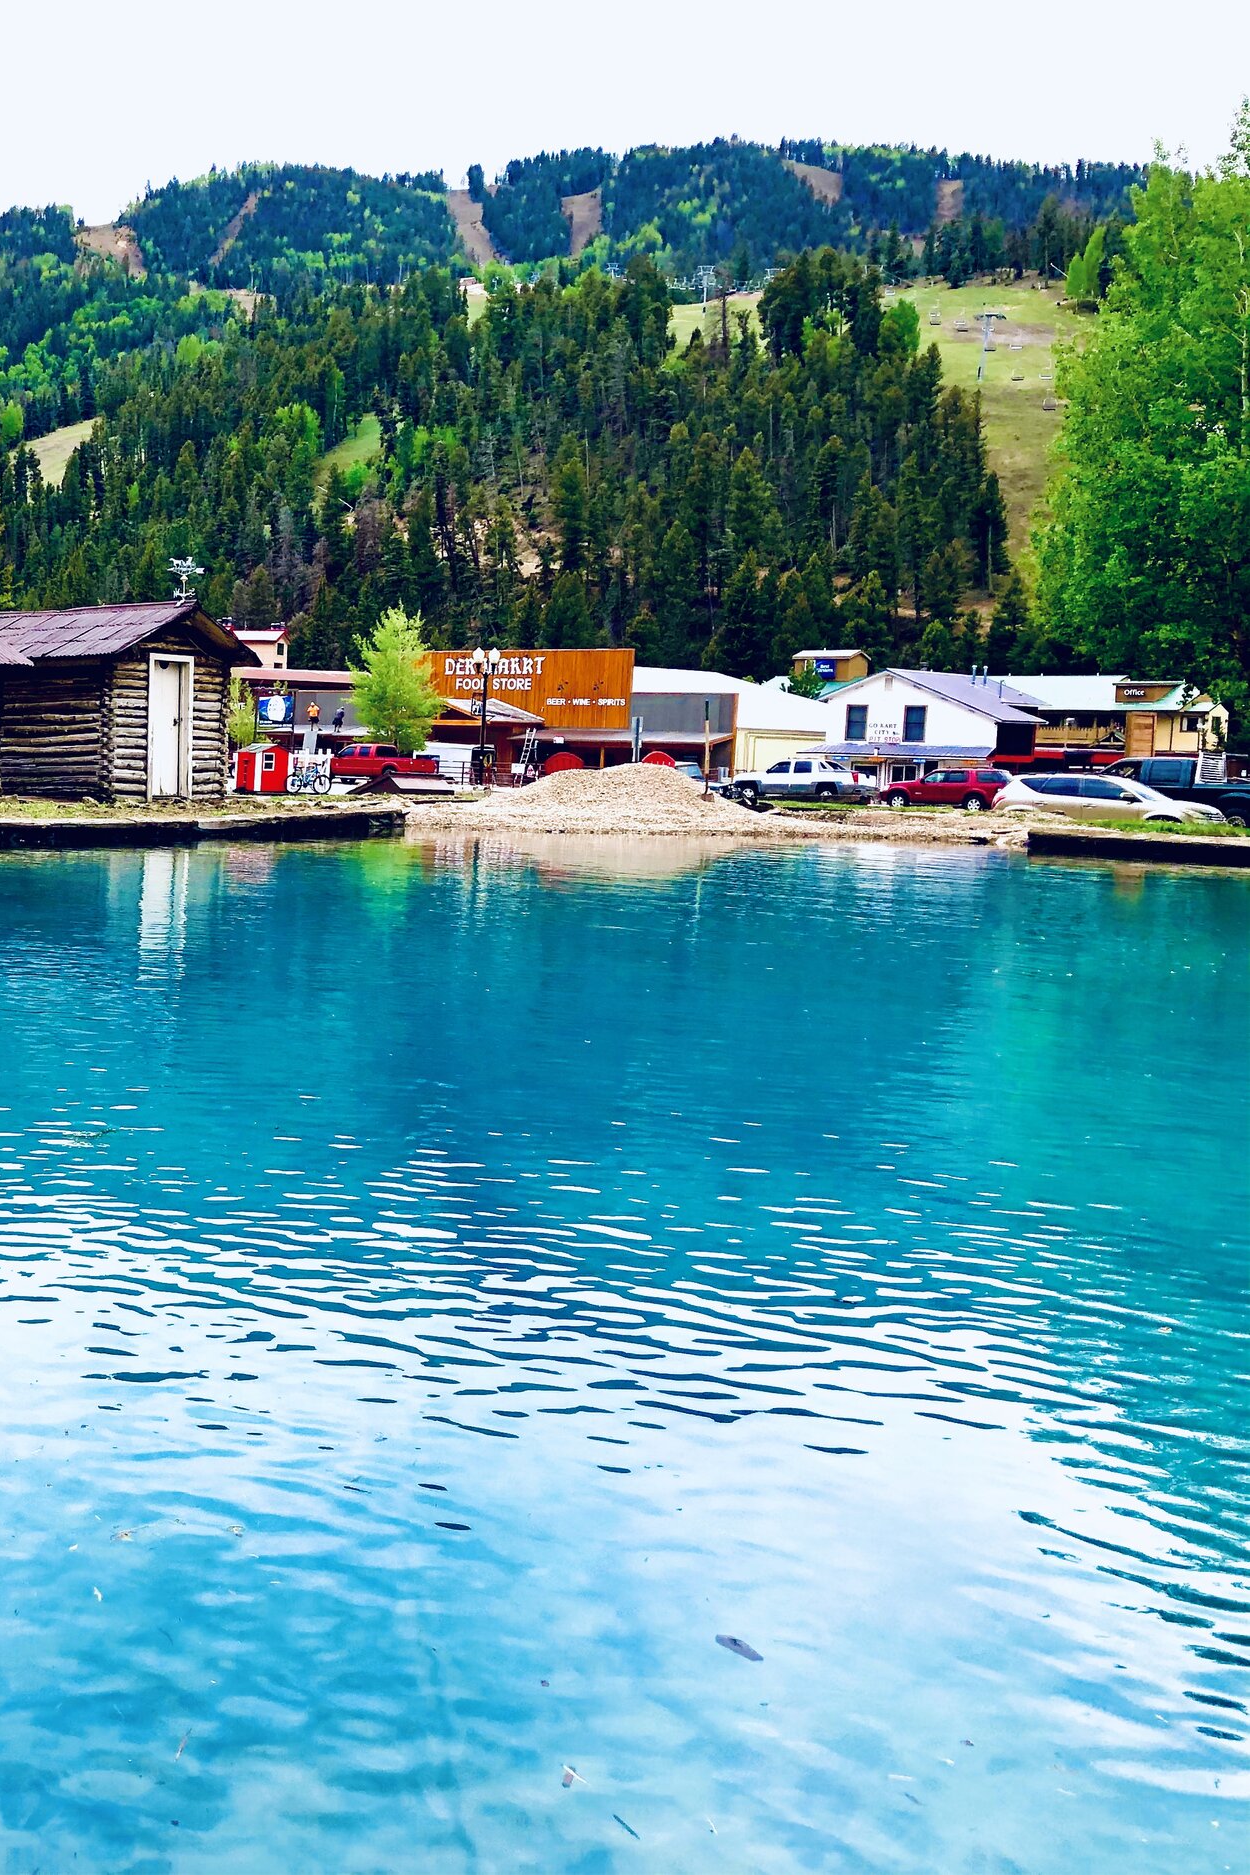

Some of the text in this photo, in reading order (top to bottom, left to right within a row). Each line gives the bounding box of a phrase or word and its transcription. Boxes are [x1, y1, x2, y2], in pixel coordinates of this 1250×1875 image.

[444, 657, 476, 675] DER
[492, 677, 532, 690] STORE
[546, 698, 626, 706] BEER WINE SPIRITS
